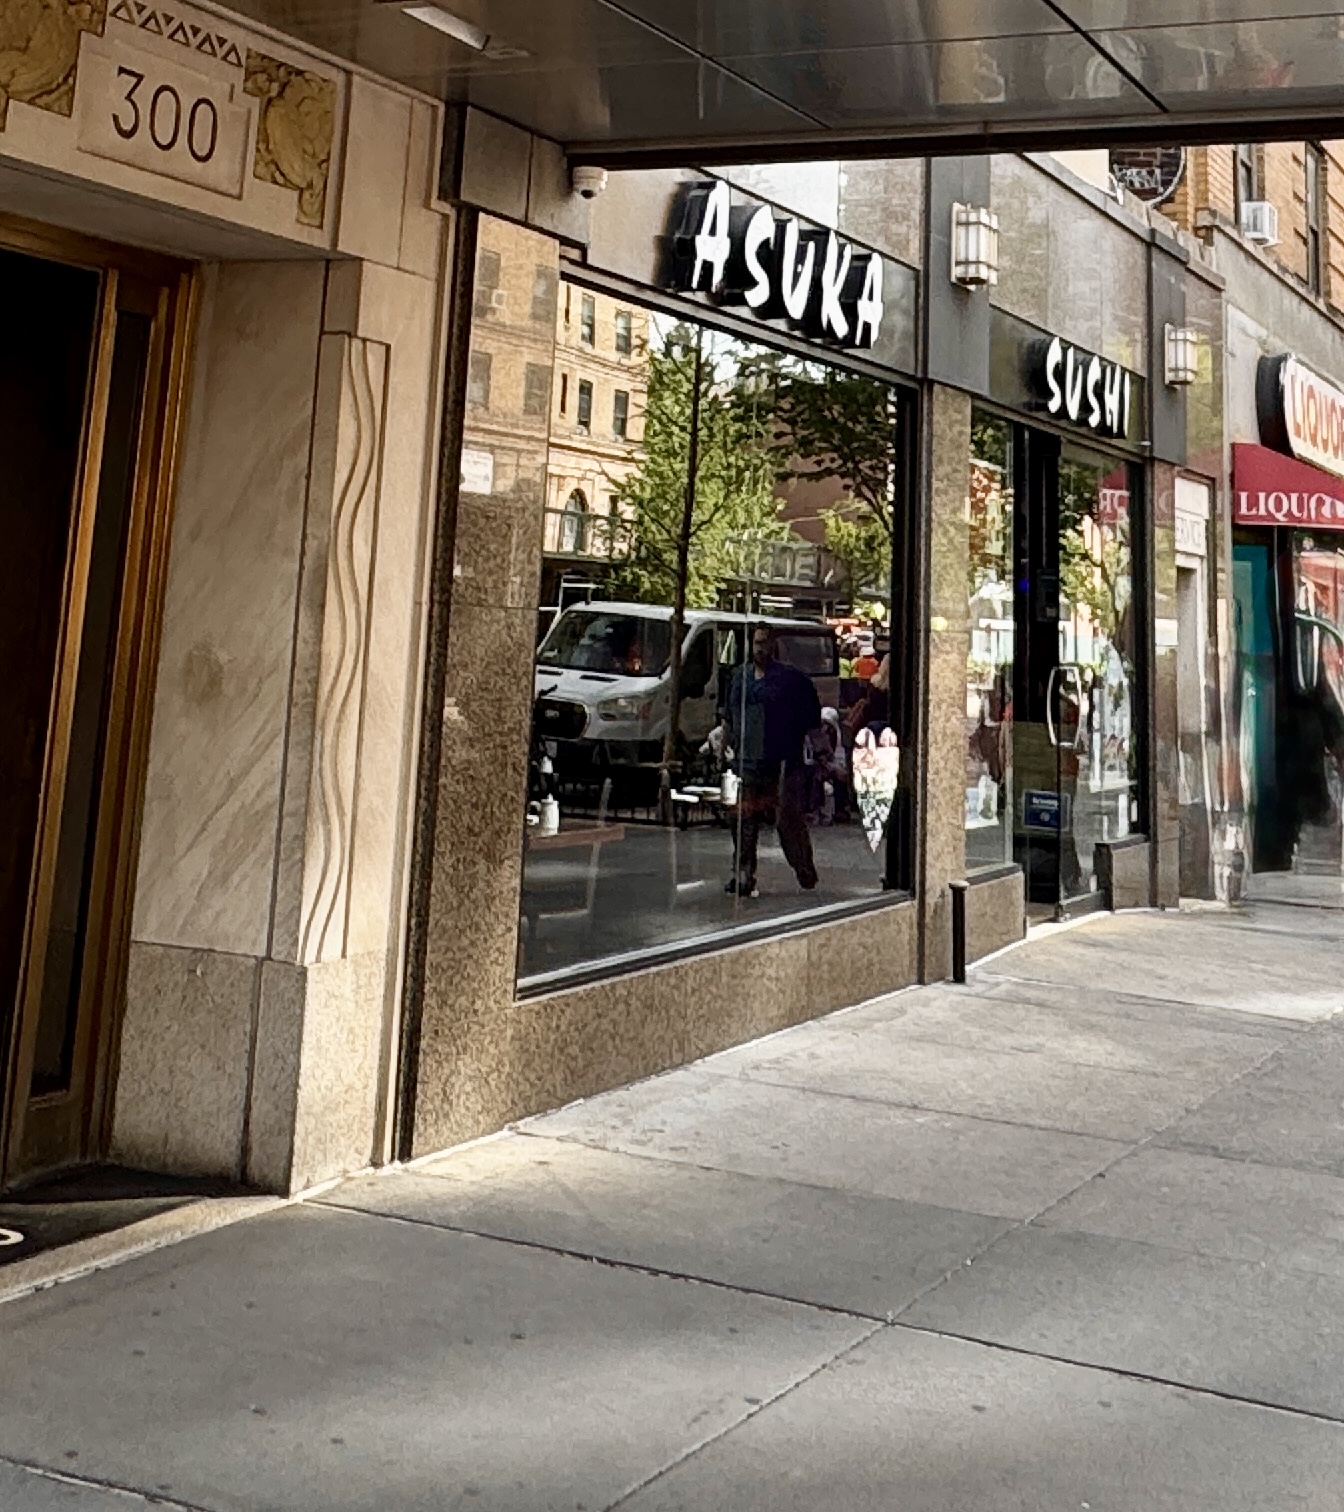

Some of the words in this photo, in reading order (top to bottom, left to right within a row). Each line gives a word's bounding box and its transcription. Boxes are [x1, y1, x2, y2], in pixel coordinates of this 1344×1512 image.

[112, 65, 219, 164] 300
[691, 180, 885, 349] ASUKA
[1046, 335, 1131, 438] SUSHI
